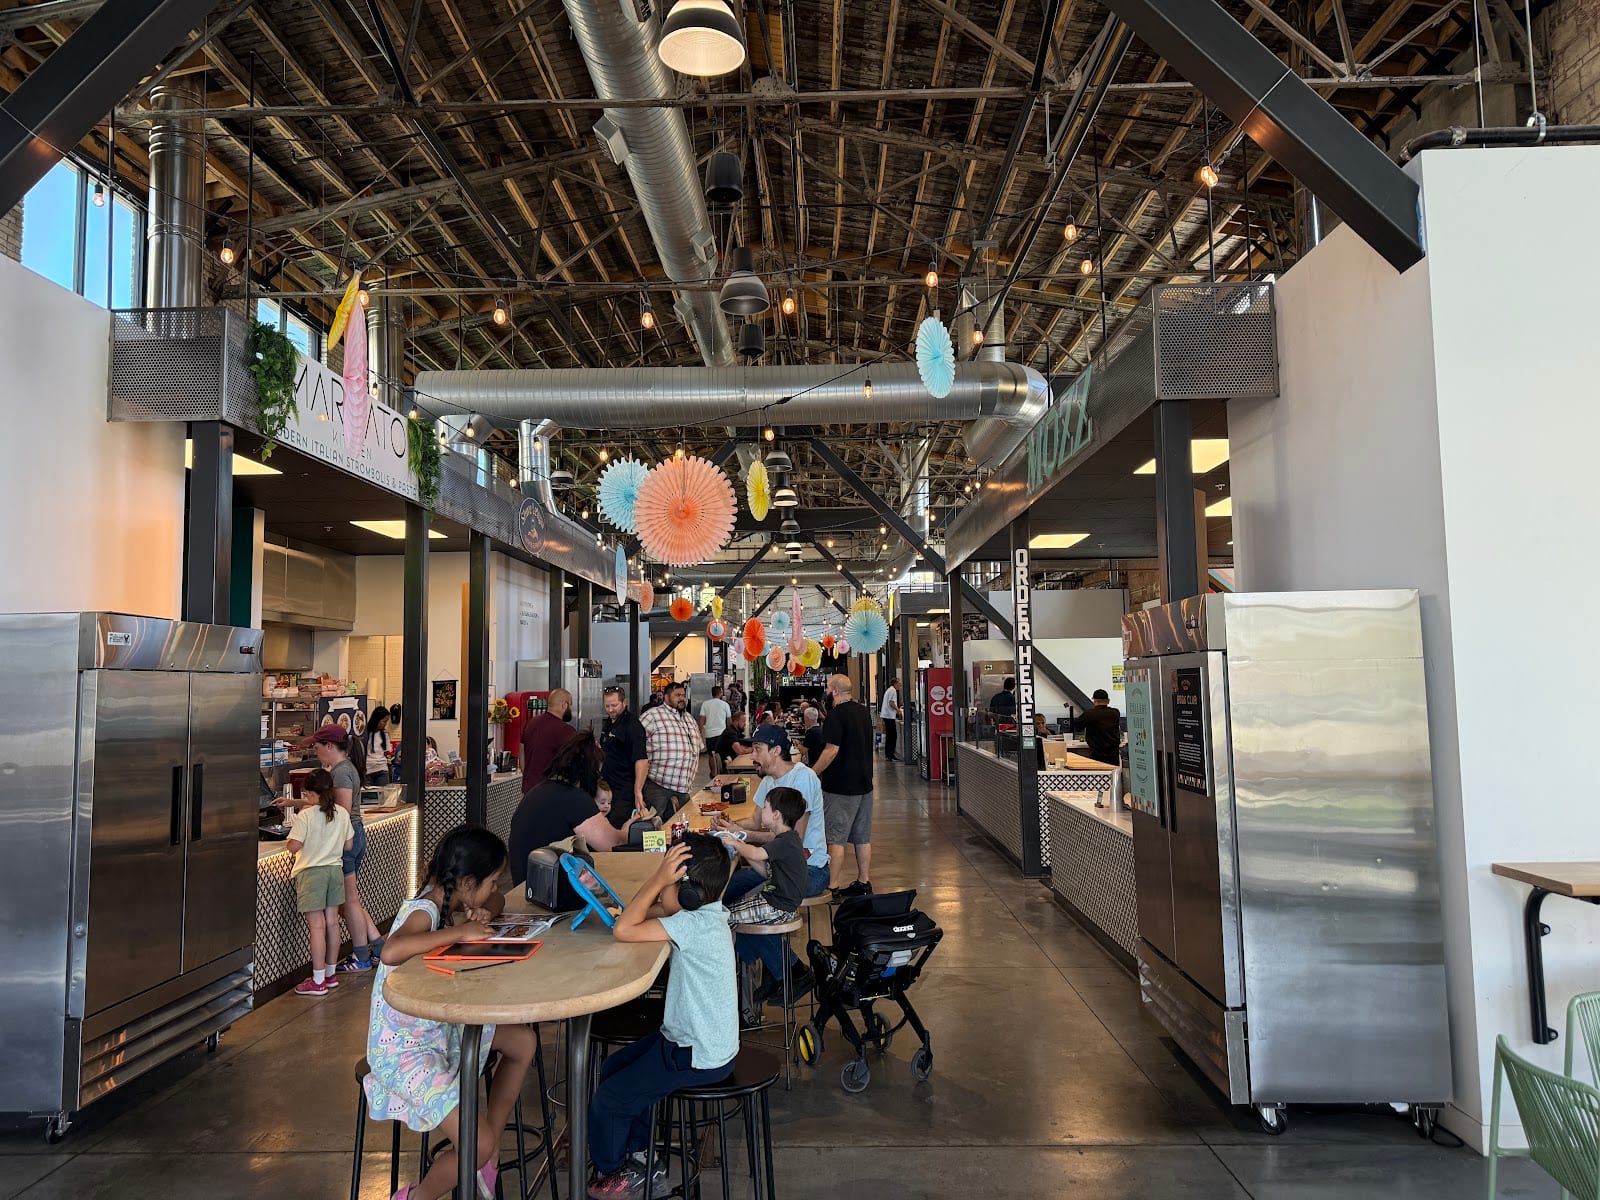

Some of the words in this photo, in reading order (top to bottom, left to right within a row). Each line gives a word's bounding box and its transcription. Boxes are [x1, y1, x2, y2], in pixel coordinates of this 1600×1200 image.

[294, 364, 407, 458] MARATO
[311, 439, 344, 466] ITALIAN
[346, 457, 390, 485] STROMBOLIS
[392, 477, 397, 489] &
[398, 481, 417, 497] PASTA
[1015, 549, 1031, 640] ORDER
[1018, 645, 1034, 724] HERE
